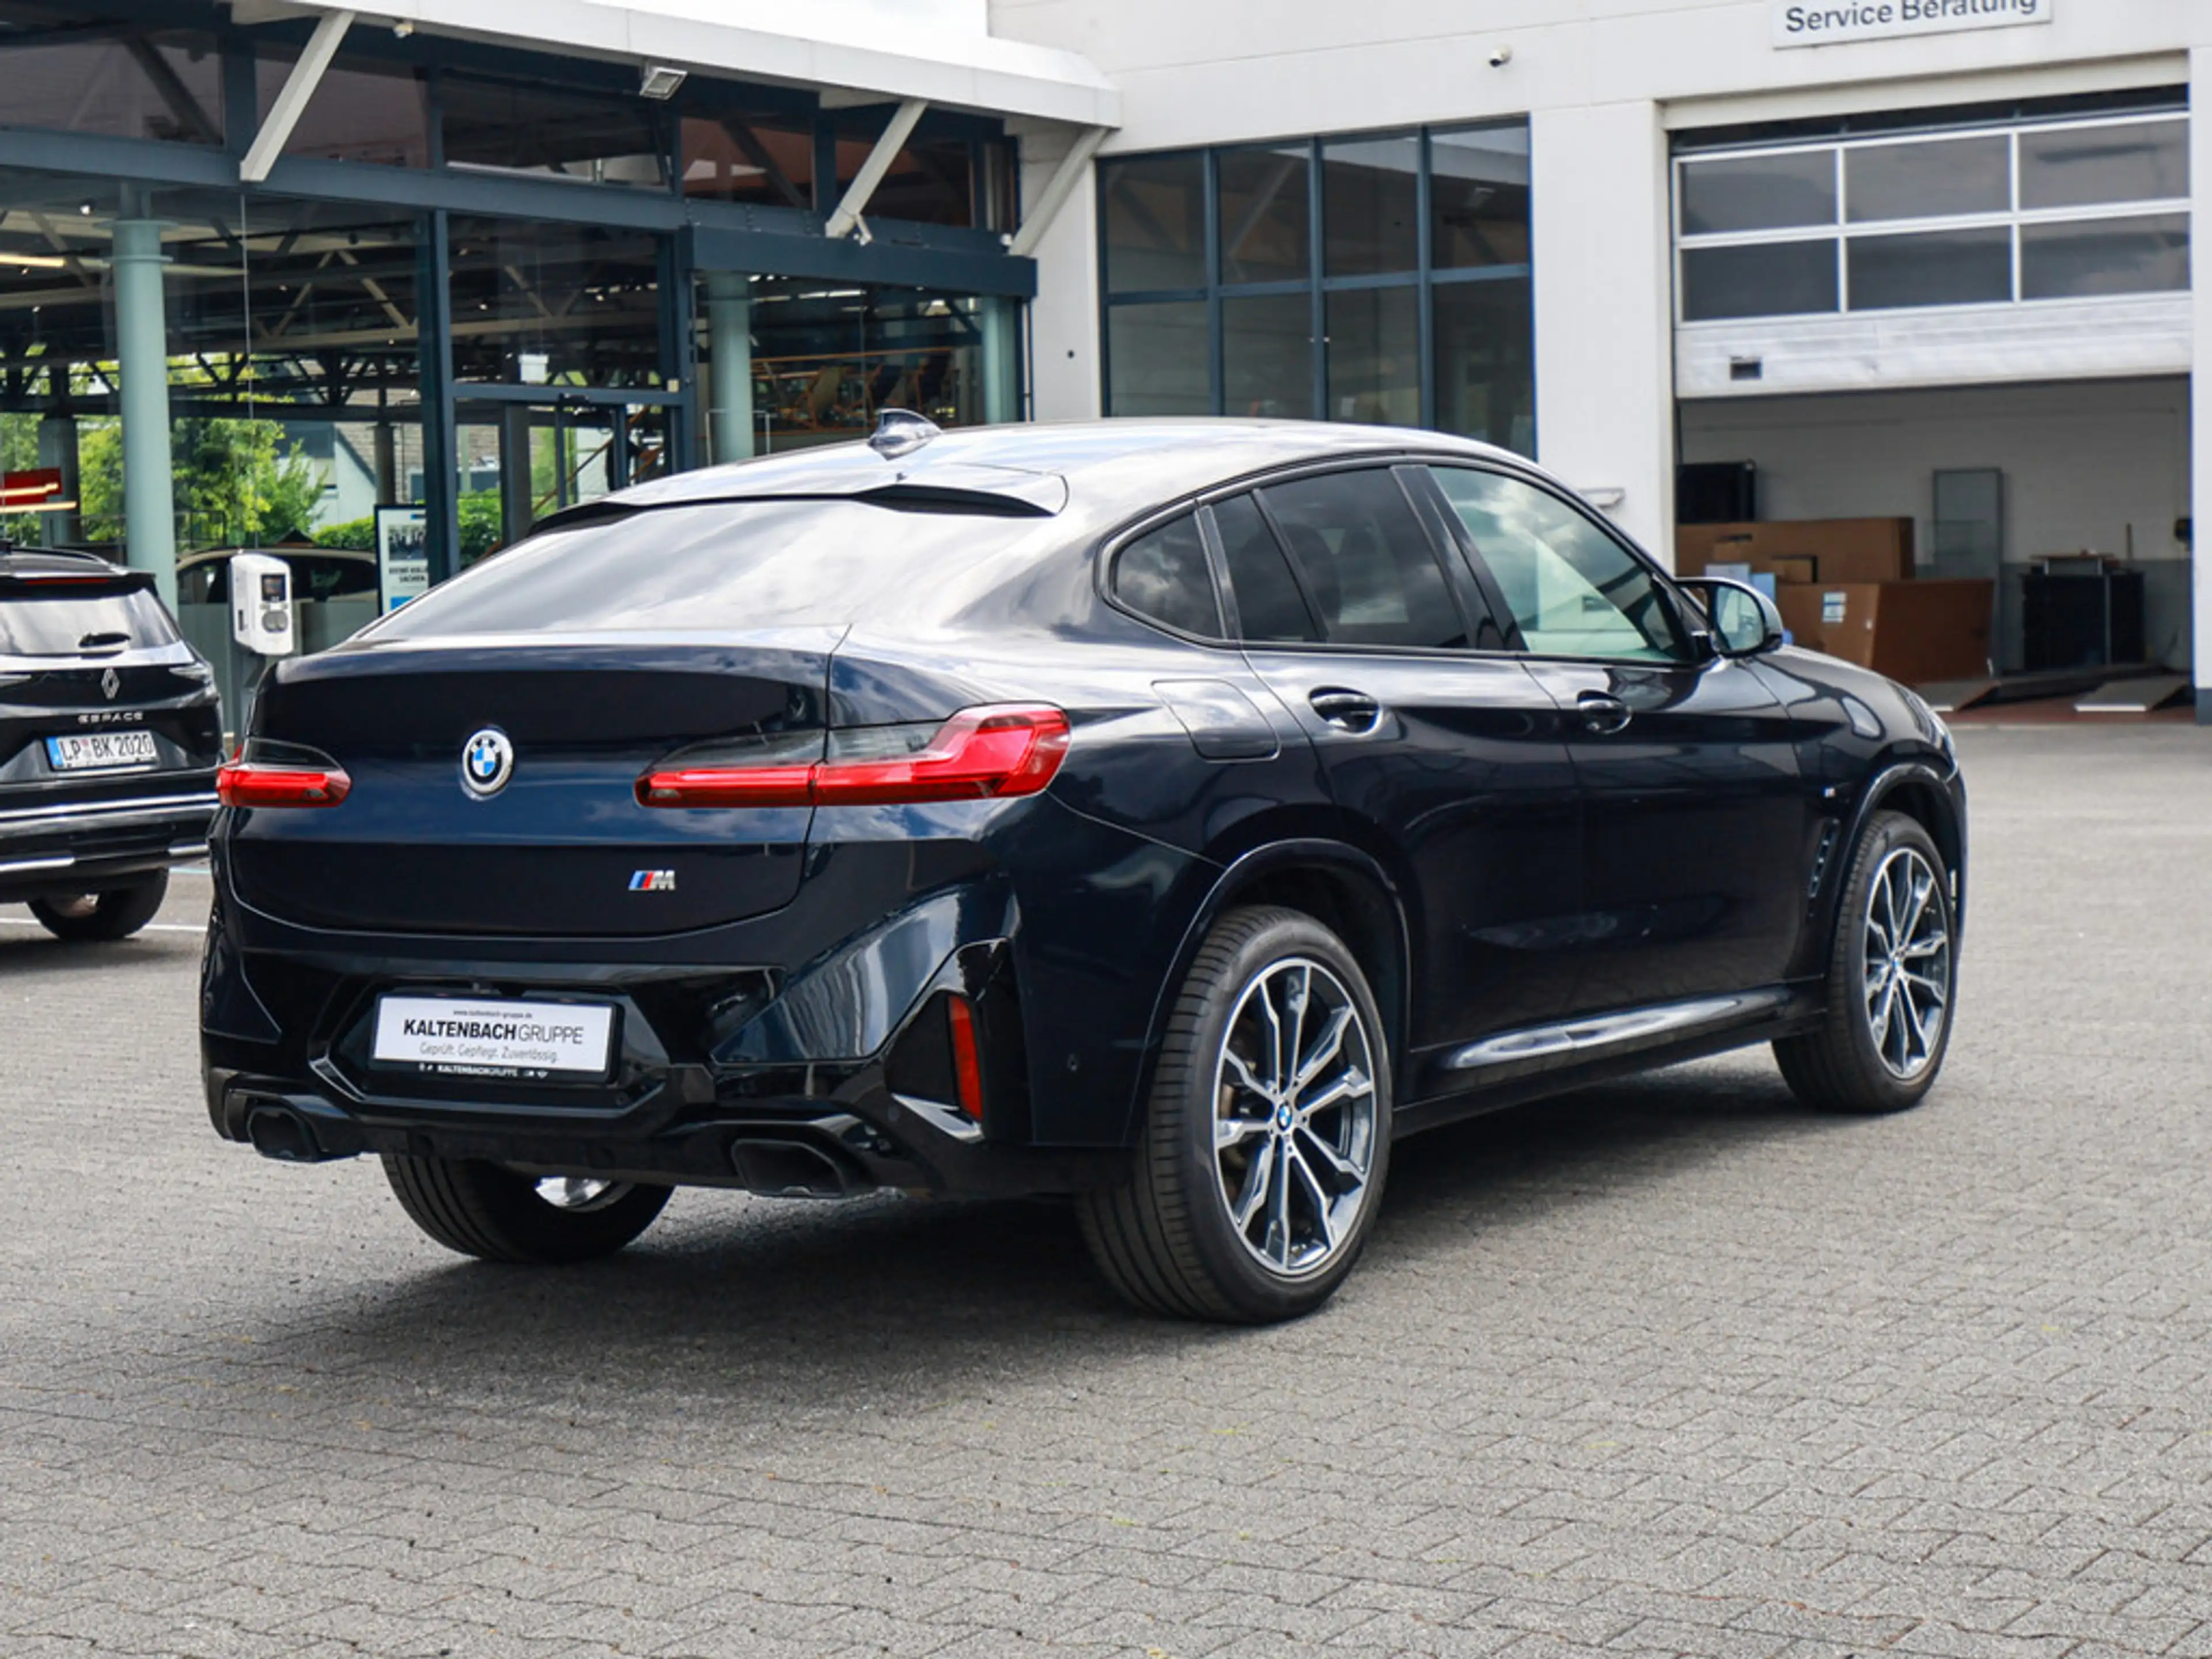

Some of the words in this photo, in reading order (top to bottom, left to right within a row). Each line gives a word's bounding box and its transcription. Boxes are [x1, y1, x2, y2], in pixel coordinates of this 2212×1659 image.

[1786, 2, 1893, 32] Service
[1902, 0, 2037, 21] Beratung
[59, 739, 81, 760] LP
[91, 736, 114, 758] BK
[115, 734, 154, 756] 2020
